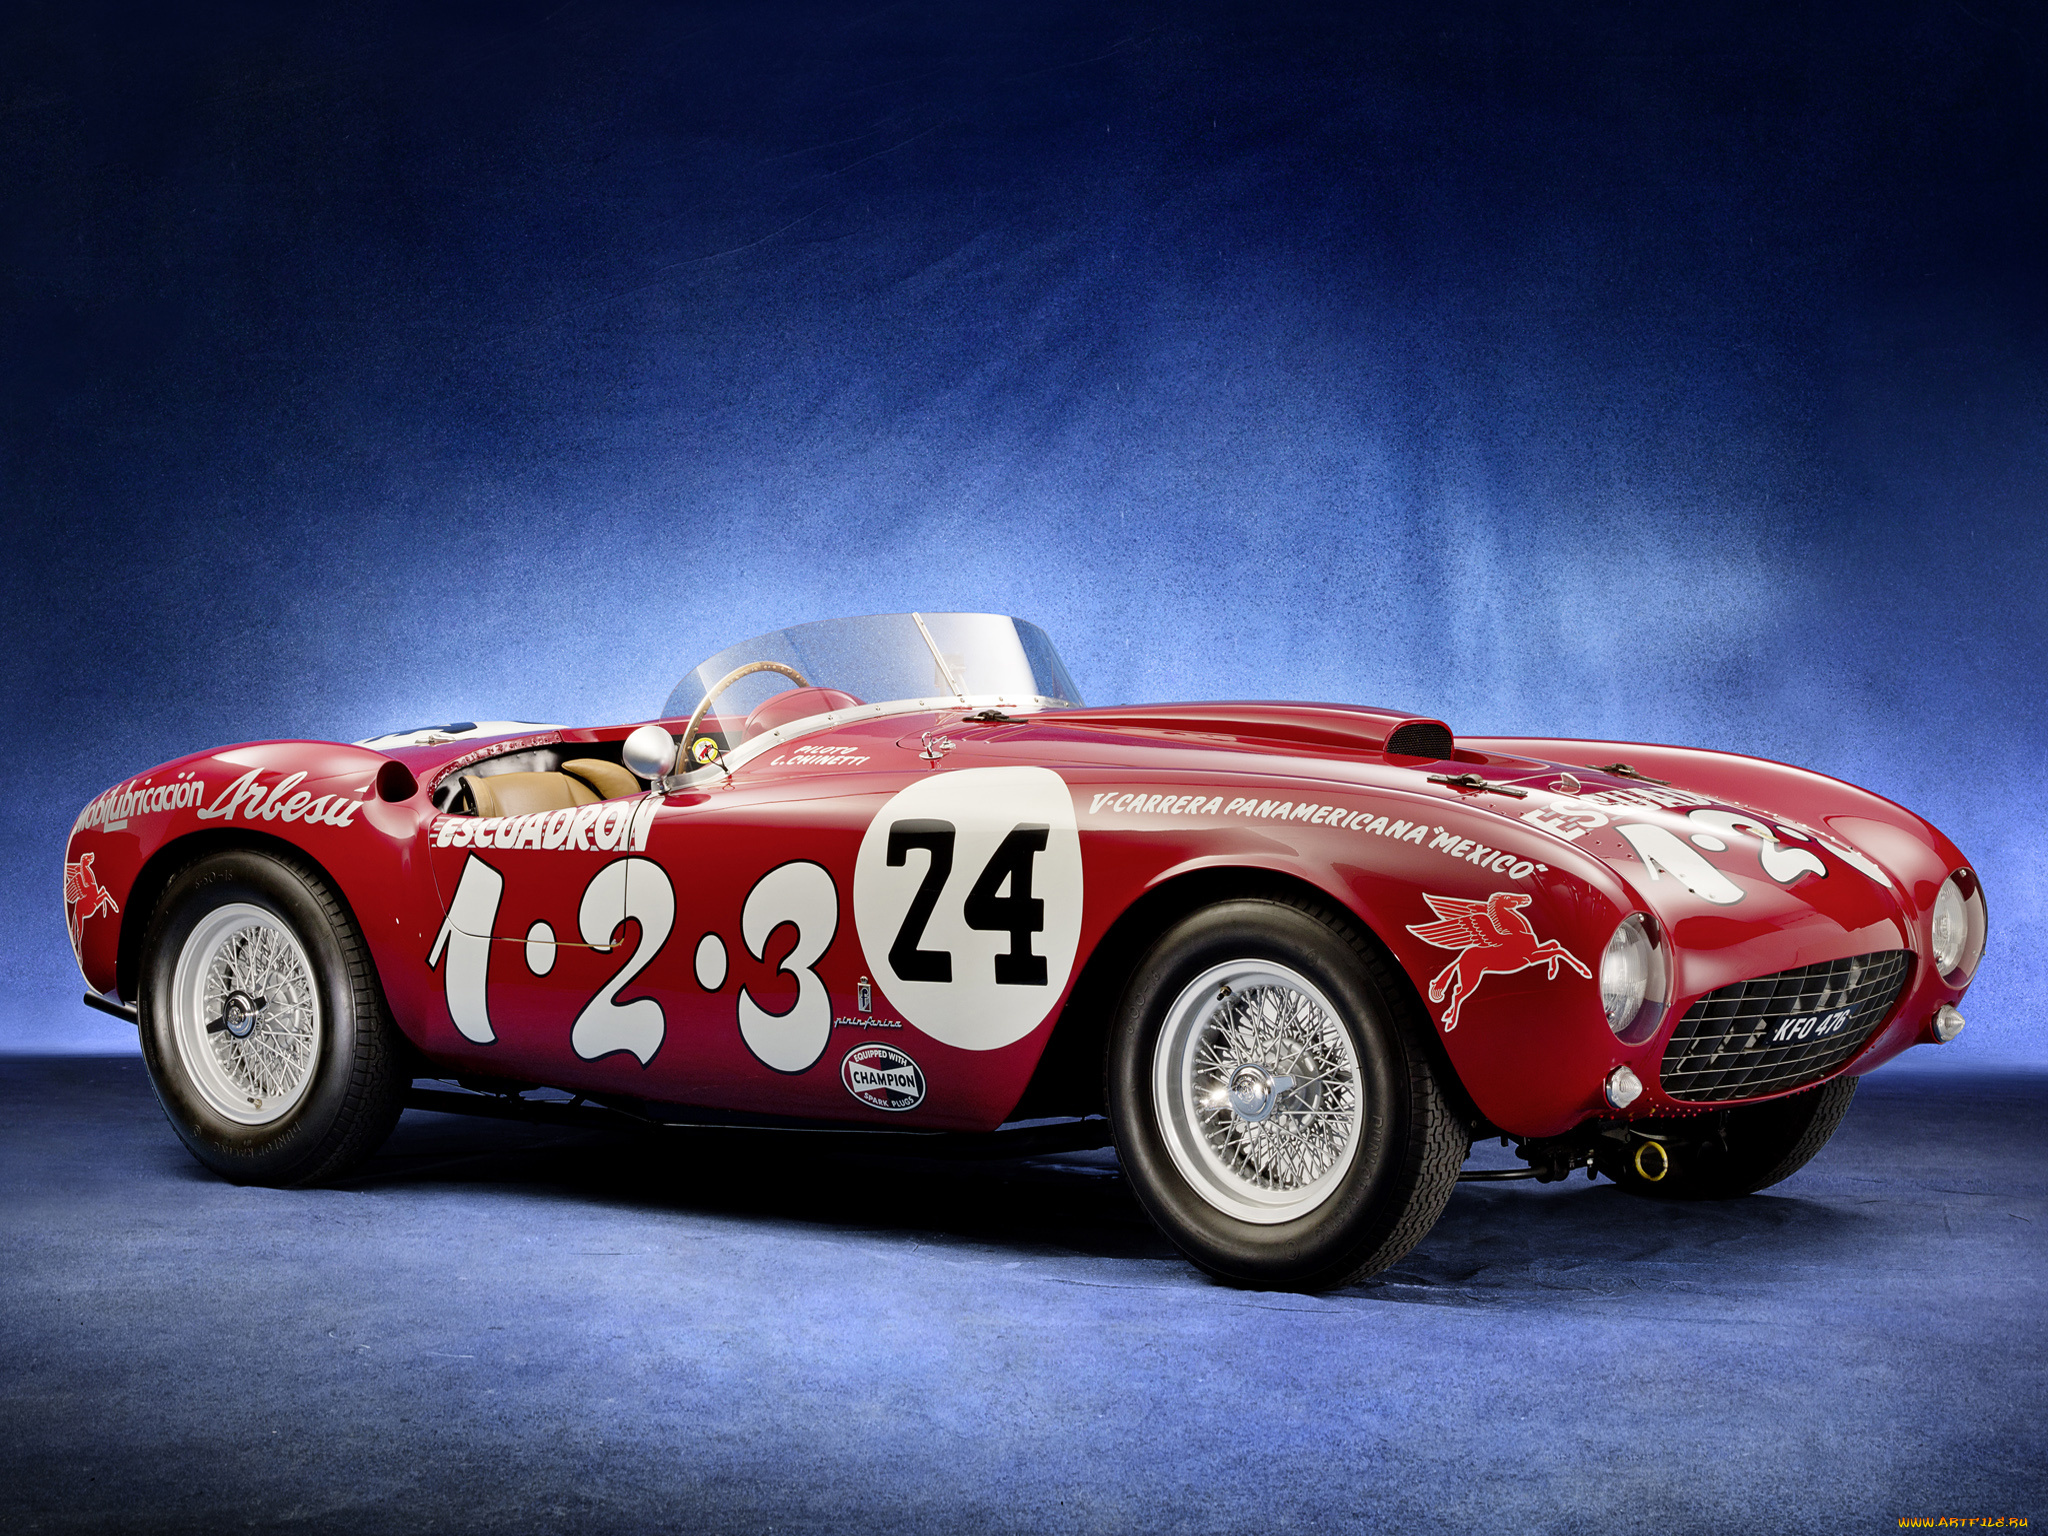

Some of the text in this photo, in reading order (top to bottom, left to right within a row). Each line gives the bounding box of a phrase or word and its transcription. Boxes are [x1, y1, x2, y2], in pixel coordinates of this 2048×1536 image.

[793, 745, 858, 755] PILOTO
[434, 795, 666, 852] ESCUADRON
[1223, 797, 1429, 845] PANAMERICANA
[886, 817, 1051, 986] 24
[1772, 1008, 1852, 1042] KFO 476
[853, 1049, 908, 1067] EQUIPPED WITH
[853, 1071, 916, 1088] CHAMPION
[863, 1092, 915, 1108] SPARK PLUGS
